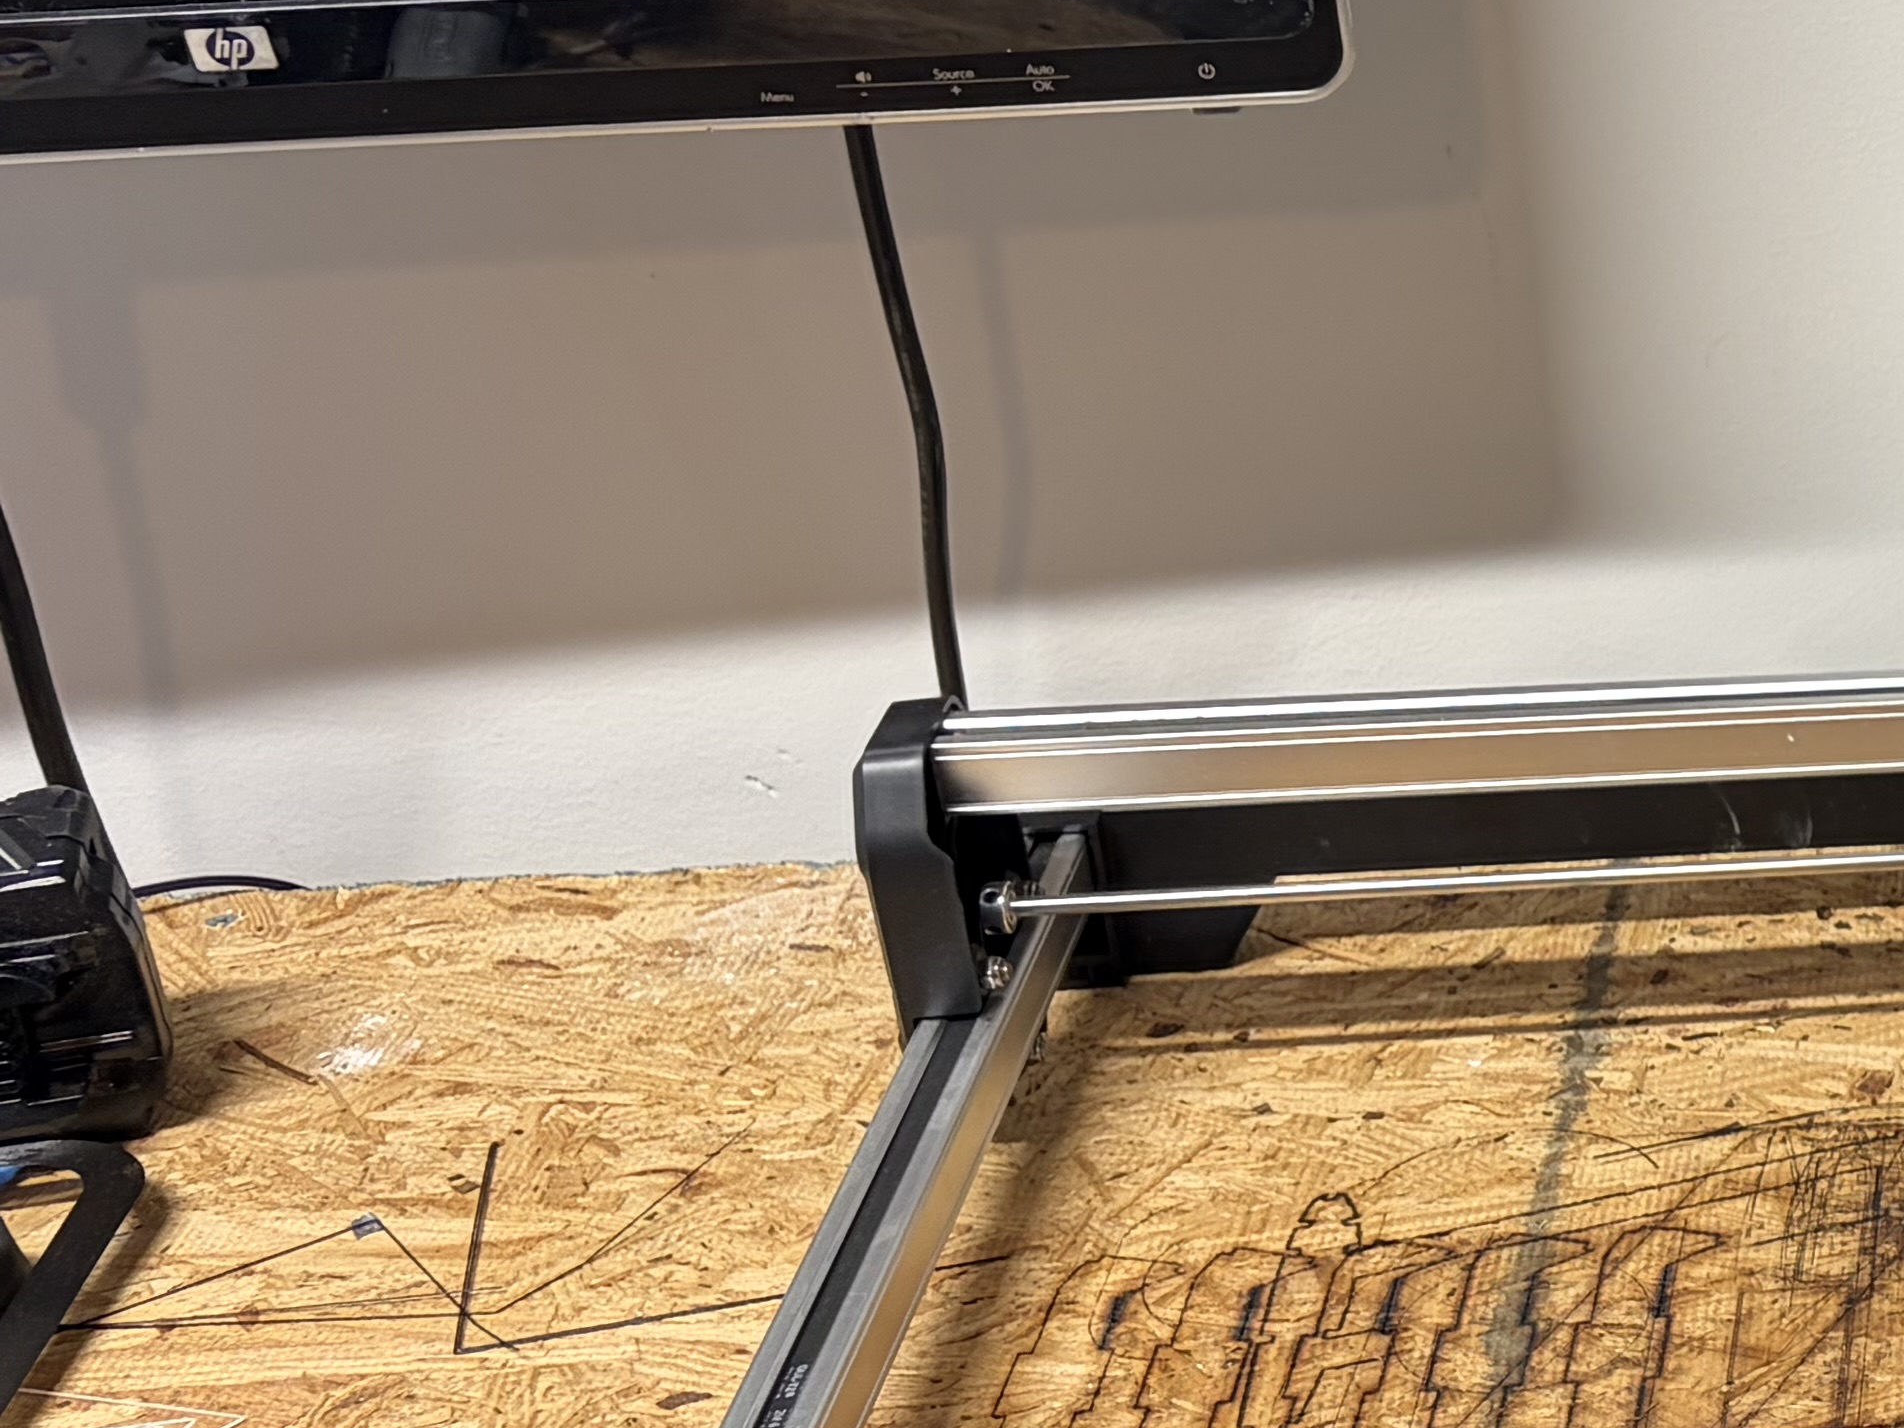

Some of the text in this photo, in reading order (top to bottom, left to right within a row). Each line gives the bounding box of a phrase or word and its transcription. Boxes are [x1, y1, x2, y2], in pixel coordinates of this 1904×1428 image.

[932, 68, 975, 80] Source
[1026, 63, 1055, 76] Auto
[1032, 80, 1055, 92] OK
[760, 91, 794, 103] Menu
